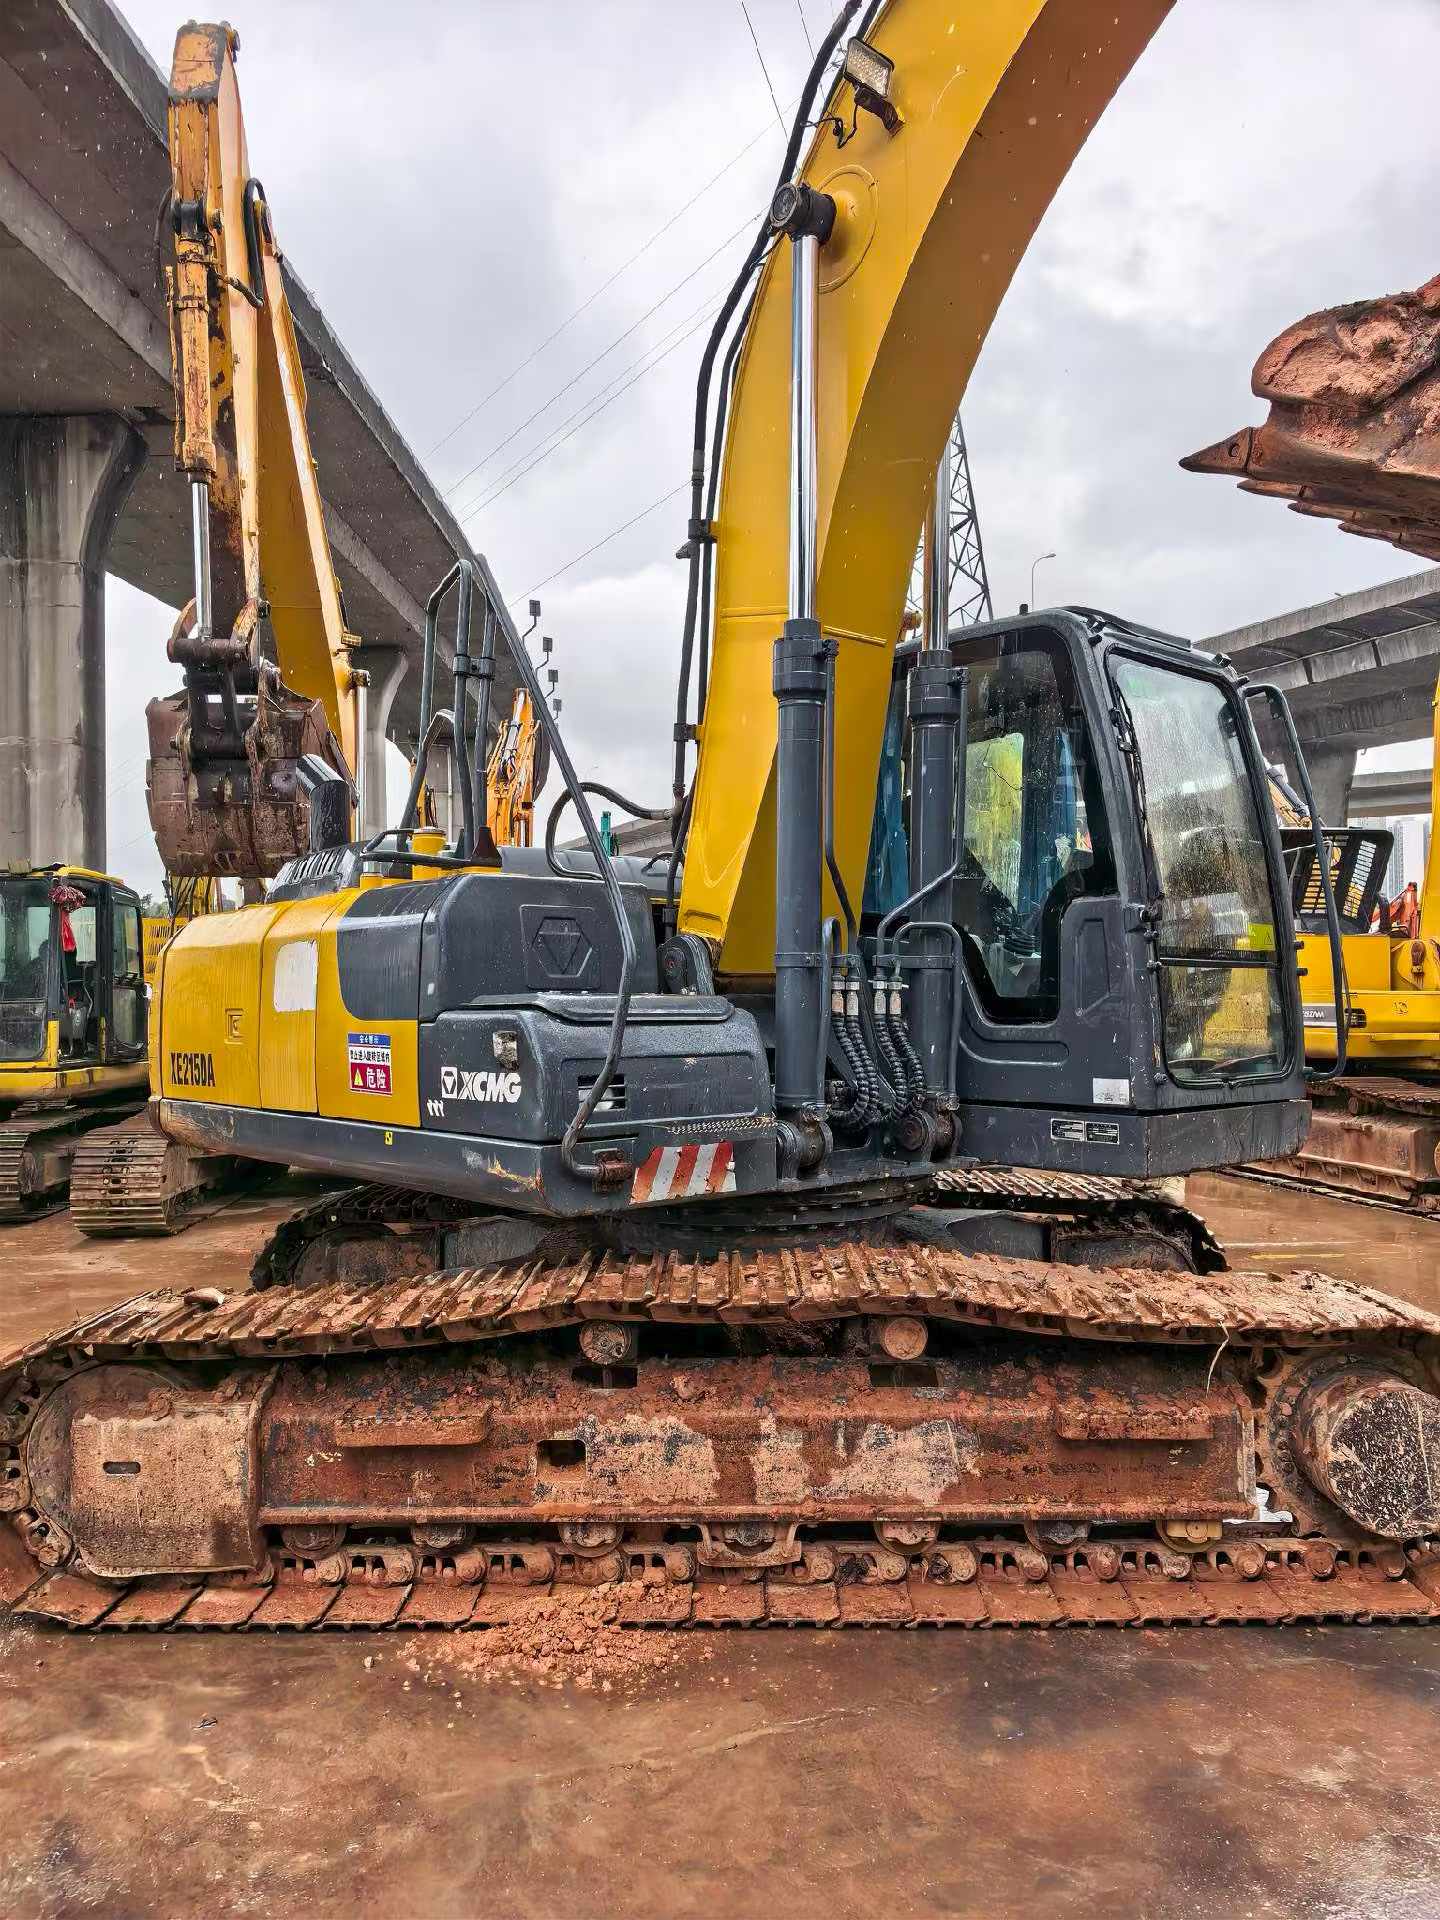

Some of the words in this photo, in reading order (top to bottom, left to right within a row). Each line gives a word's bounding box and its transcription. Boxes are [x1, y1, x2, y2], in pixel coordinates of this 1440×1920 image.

[170, 1052, 216, 1087] XE215DA
[366, 1066, 386, 1089] 危险
[457, 1071, 522, 1103] XCMG
